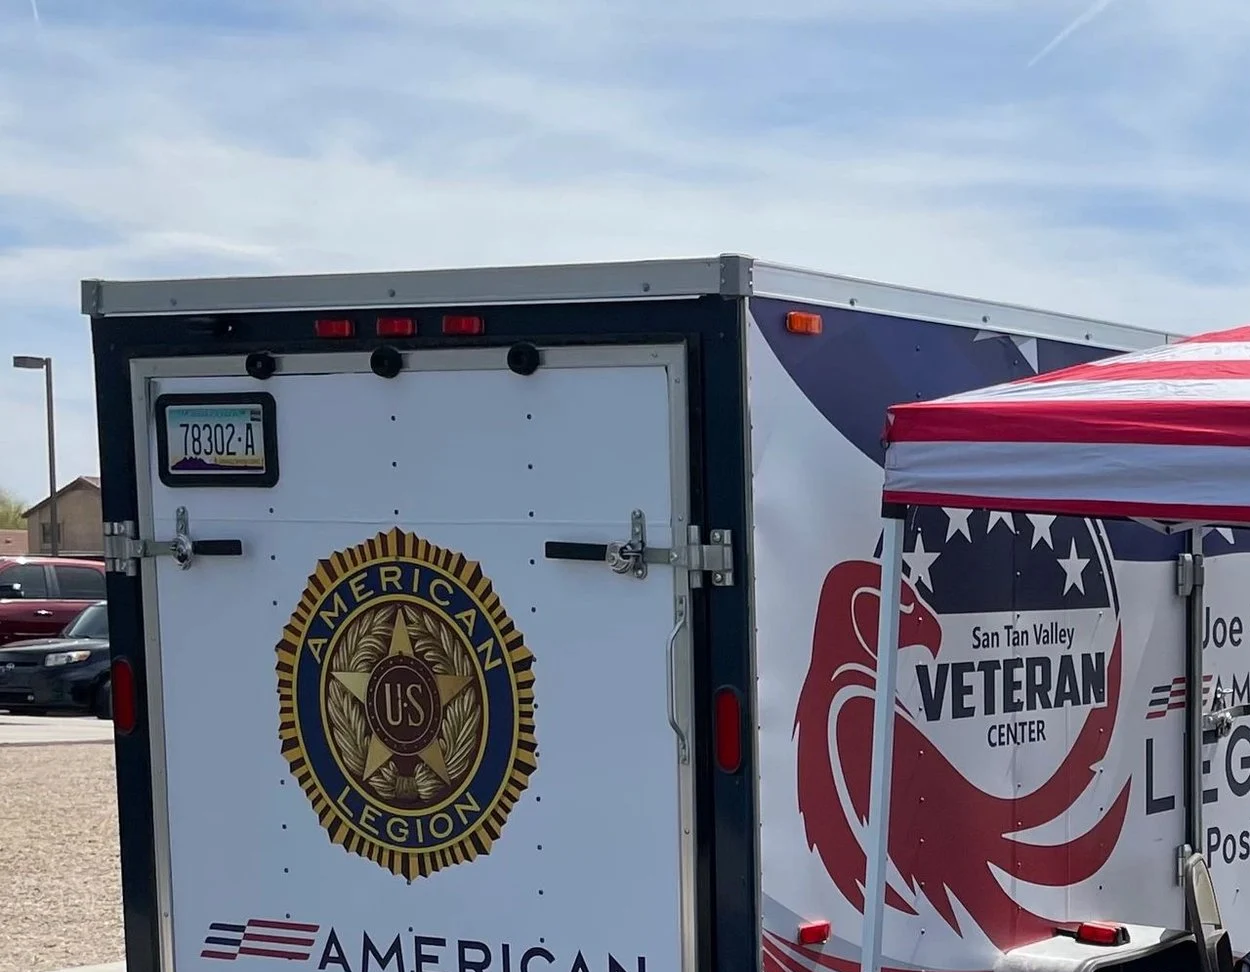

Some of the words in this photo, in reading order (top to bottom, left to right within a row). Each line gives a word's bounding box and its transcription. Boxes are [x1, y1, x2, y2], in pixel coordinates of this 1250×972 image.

[308, 566, 502, 673] AMERICAN
[972, 626, 1000, 649] San
[1004, 624, 1029, 647] Tan
[1033, 621, 1075, 650] Valley
[1202, 606, 1243, 649] Joe
[915, 651, 1106, 722] VETERAN
[987, 720, 1046, 747] CENTER
[336, 790, 482, 843] LEGION
